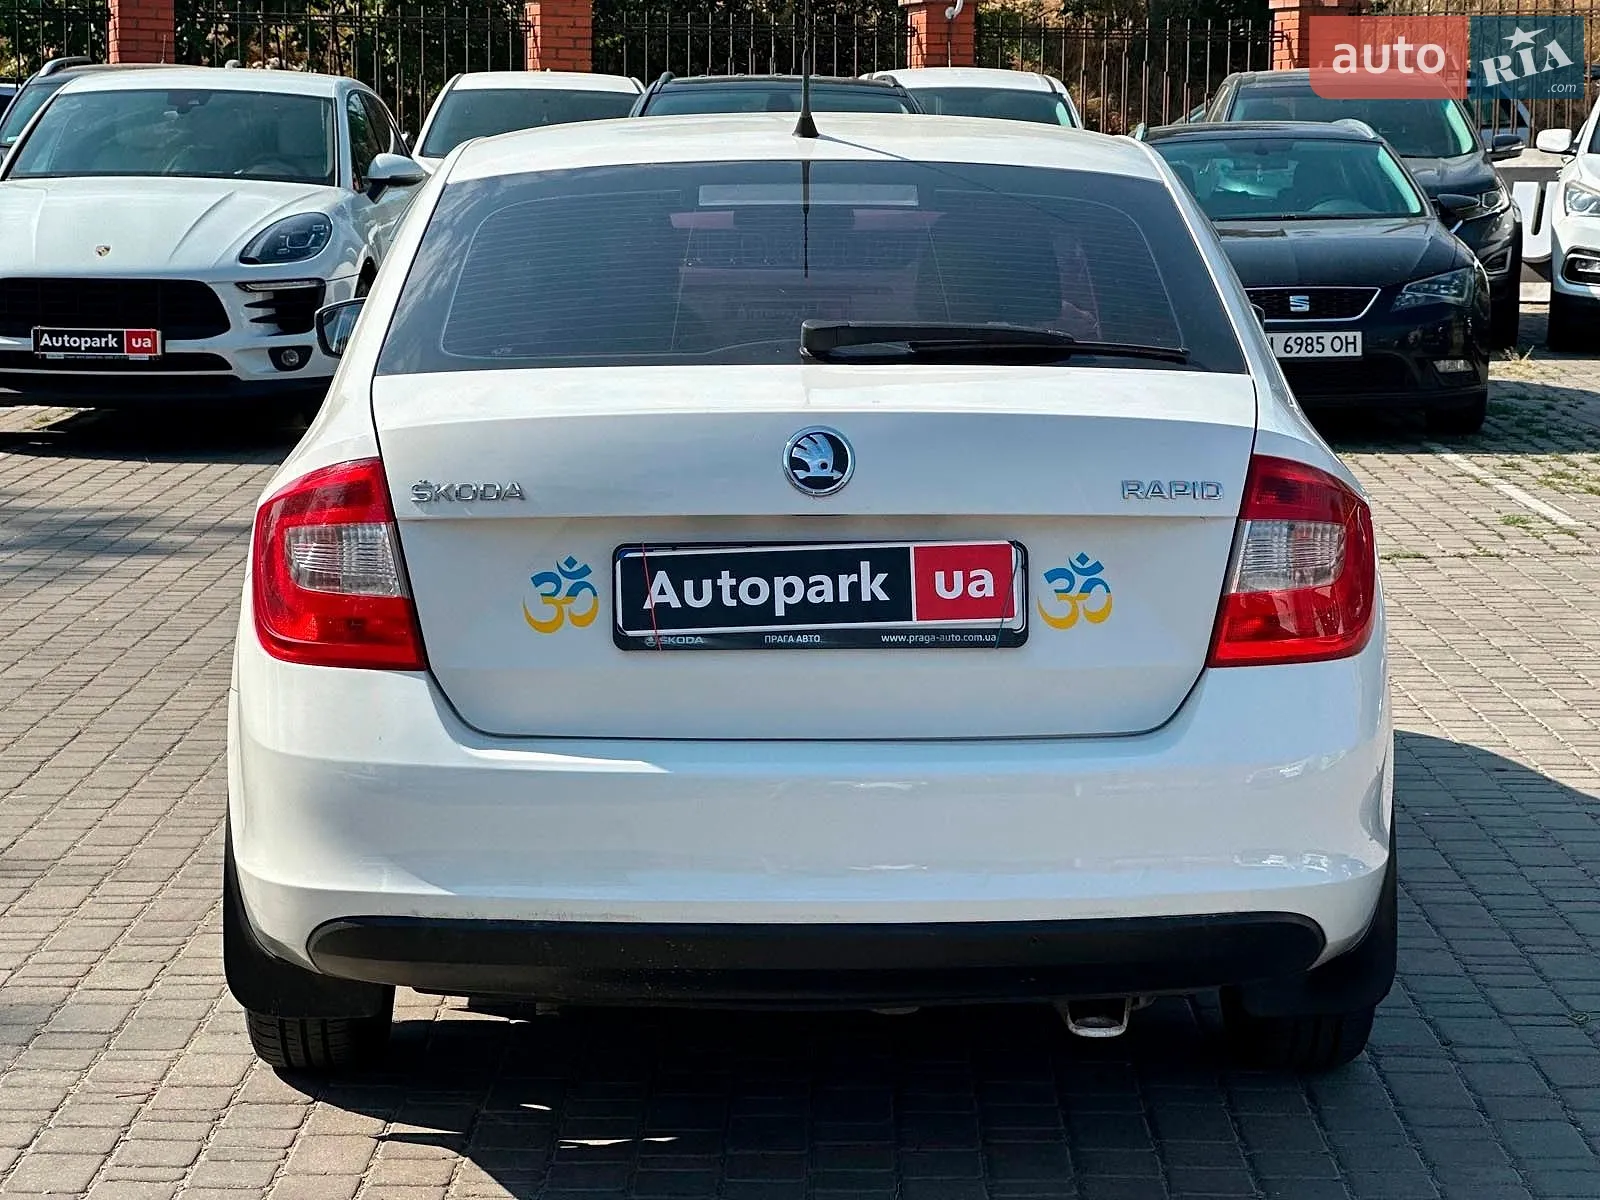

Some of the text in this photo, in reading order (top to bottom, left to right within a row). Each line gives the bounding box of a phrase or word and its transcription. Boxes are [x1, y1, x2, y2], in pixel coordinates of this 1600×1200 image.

[40, 333, 152, 351] Autopark ua
[1283, 336, 1325, 354] 6985
[1330, 335, 1357, 353] OH
[1121, 480, 1224, 500] RAPID
[642, 561, 995, 617] Autopark ua
[764, 634, 821, 644] ПРАГА АВТО
[881, 633, 997, 644] www.praga-auto.com.ua
